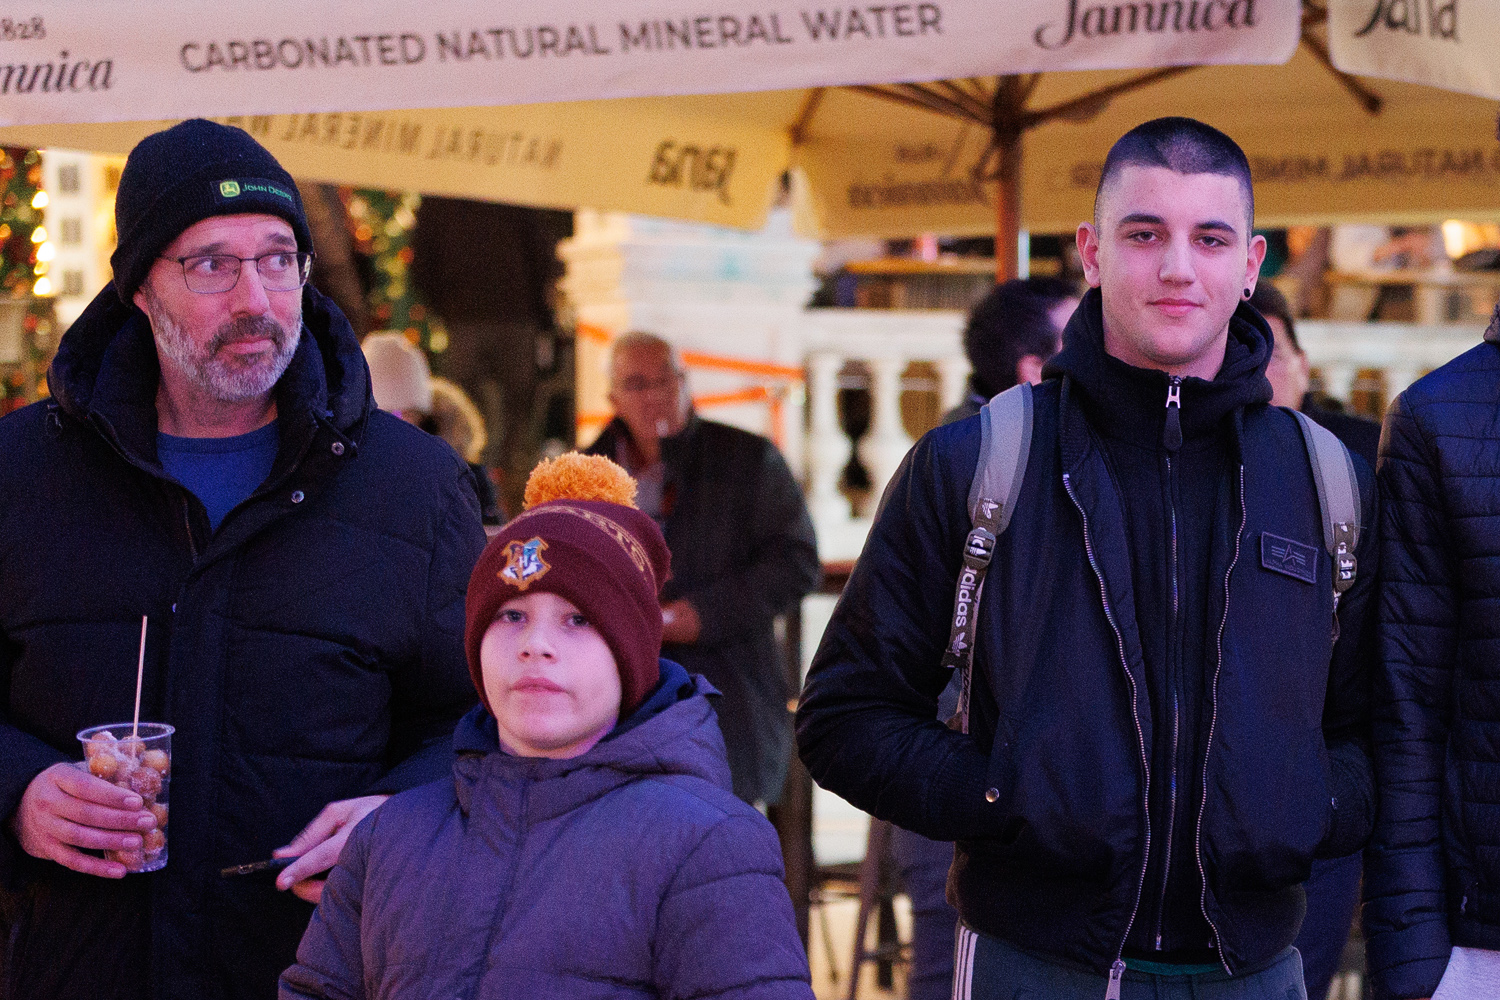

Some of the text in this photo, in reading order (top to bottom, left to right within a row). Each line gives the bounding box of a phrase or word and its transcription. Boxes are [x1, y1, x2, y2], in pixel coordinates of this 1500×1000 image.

[180, 3, 943, 73] CARBONATED NATURAL MINERAL WATER
[242, 183, 267, 192] JOHN
